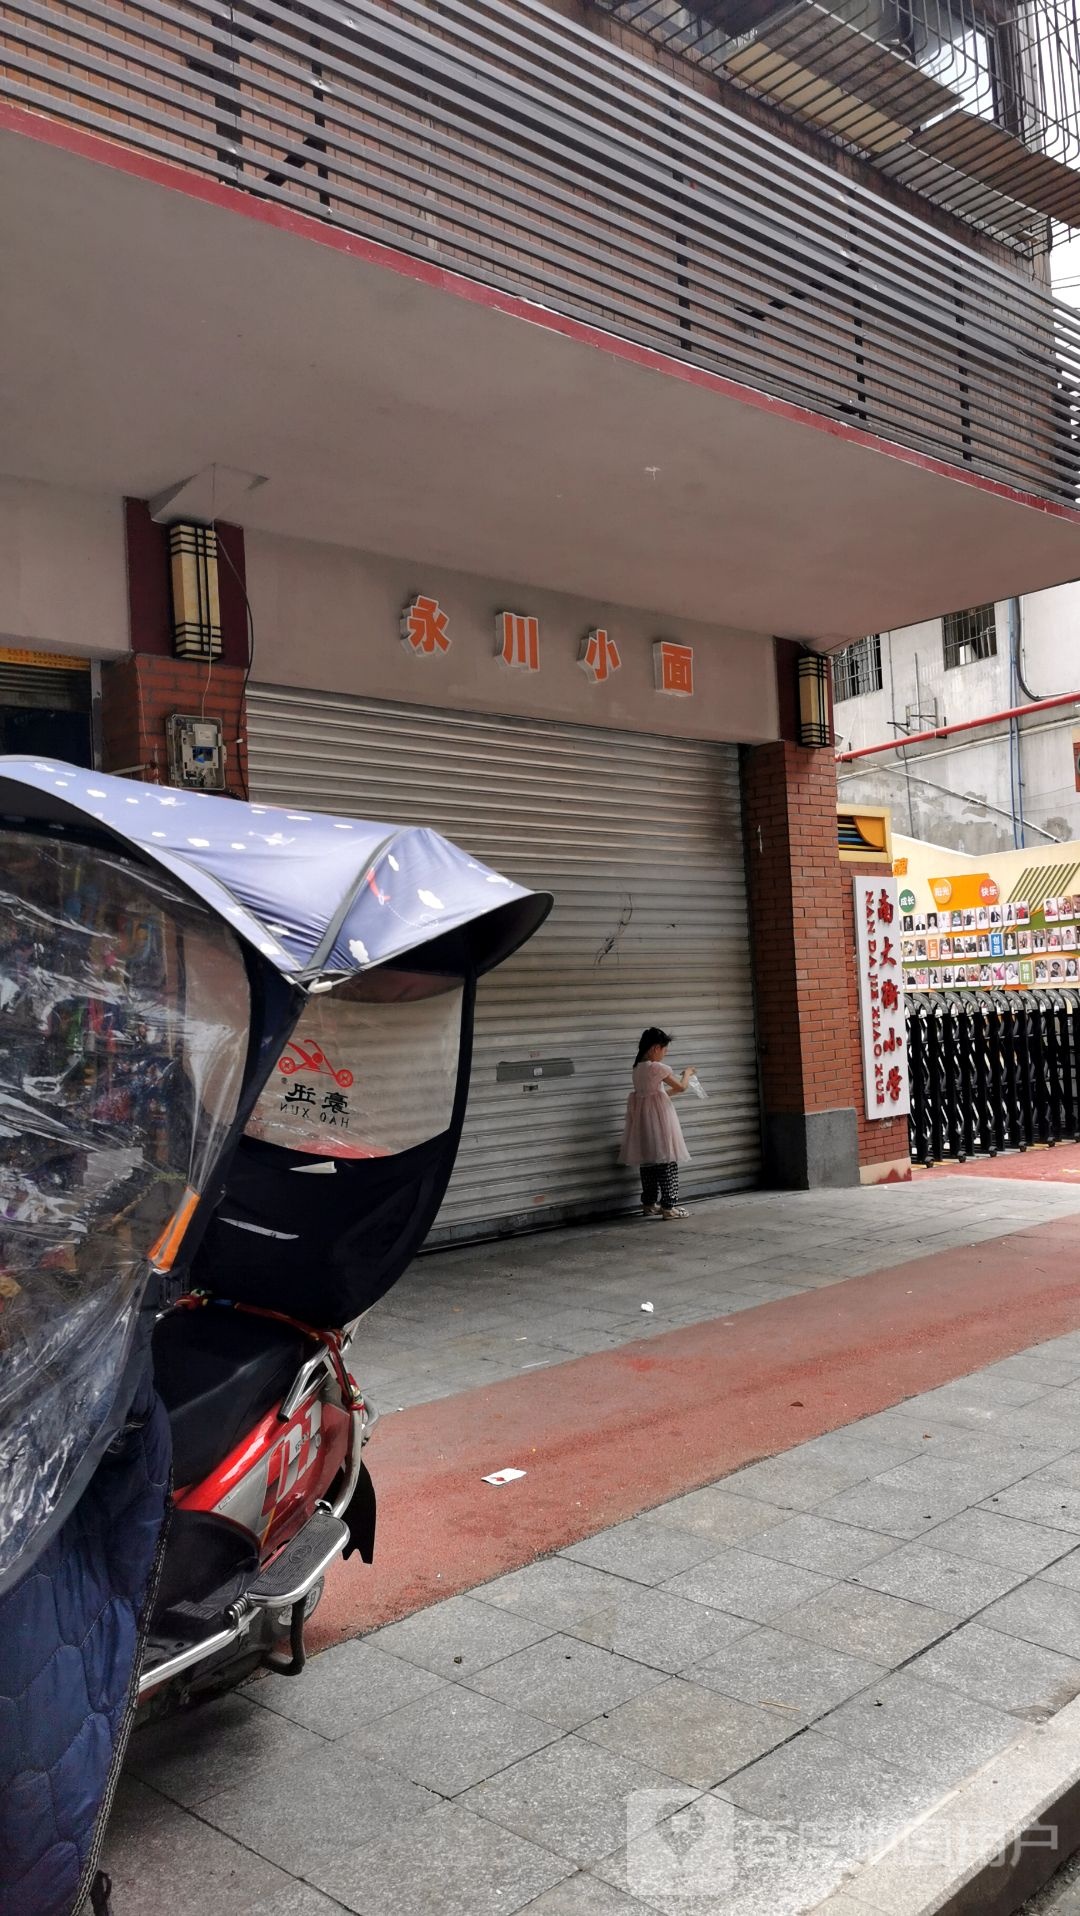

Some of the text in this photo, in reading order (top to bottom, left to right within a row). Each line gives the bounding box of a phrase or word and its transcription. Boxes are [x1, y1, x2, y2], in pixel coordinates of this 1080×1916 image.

[403, 595, 694, 697] 永川小面
[900, 895, 915, 906] 成长
[980, 885, 998, 897] 快乐
[866, 891, 875, 934] NAN
